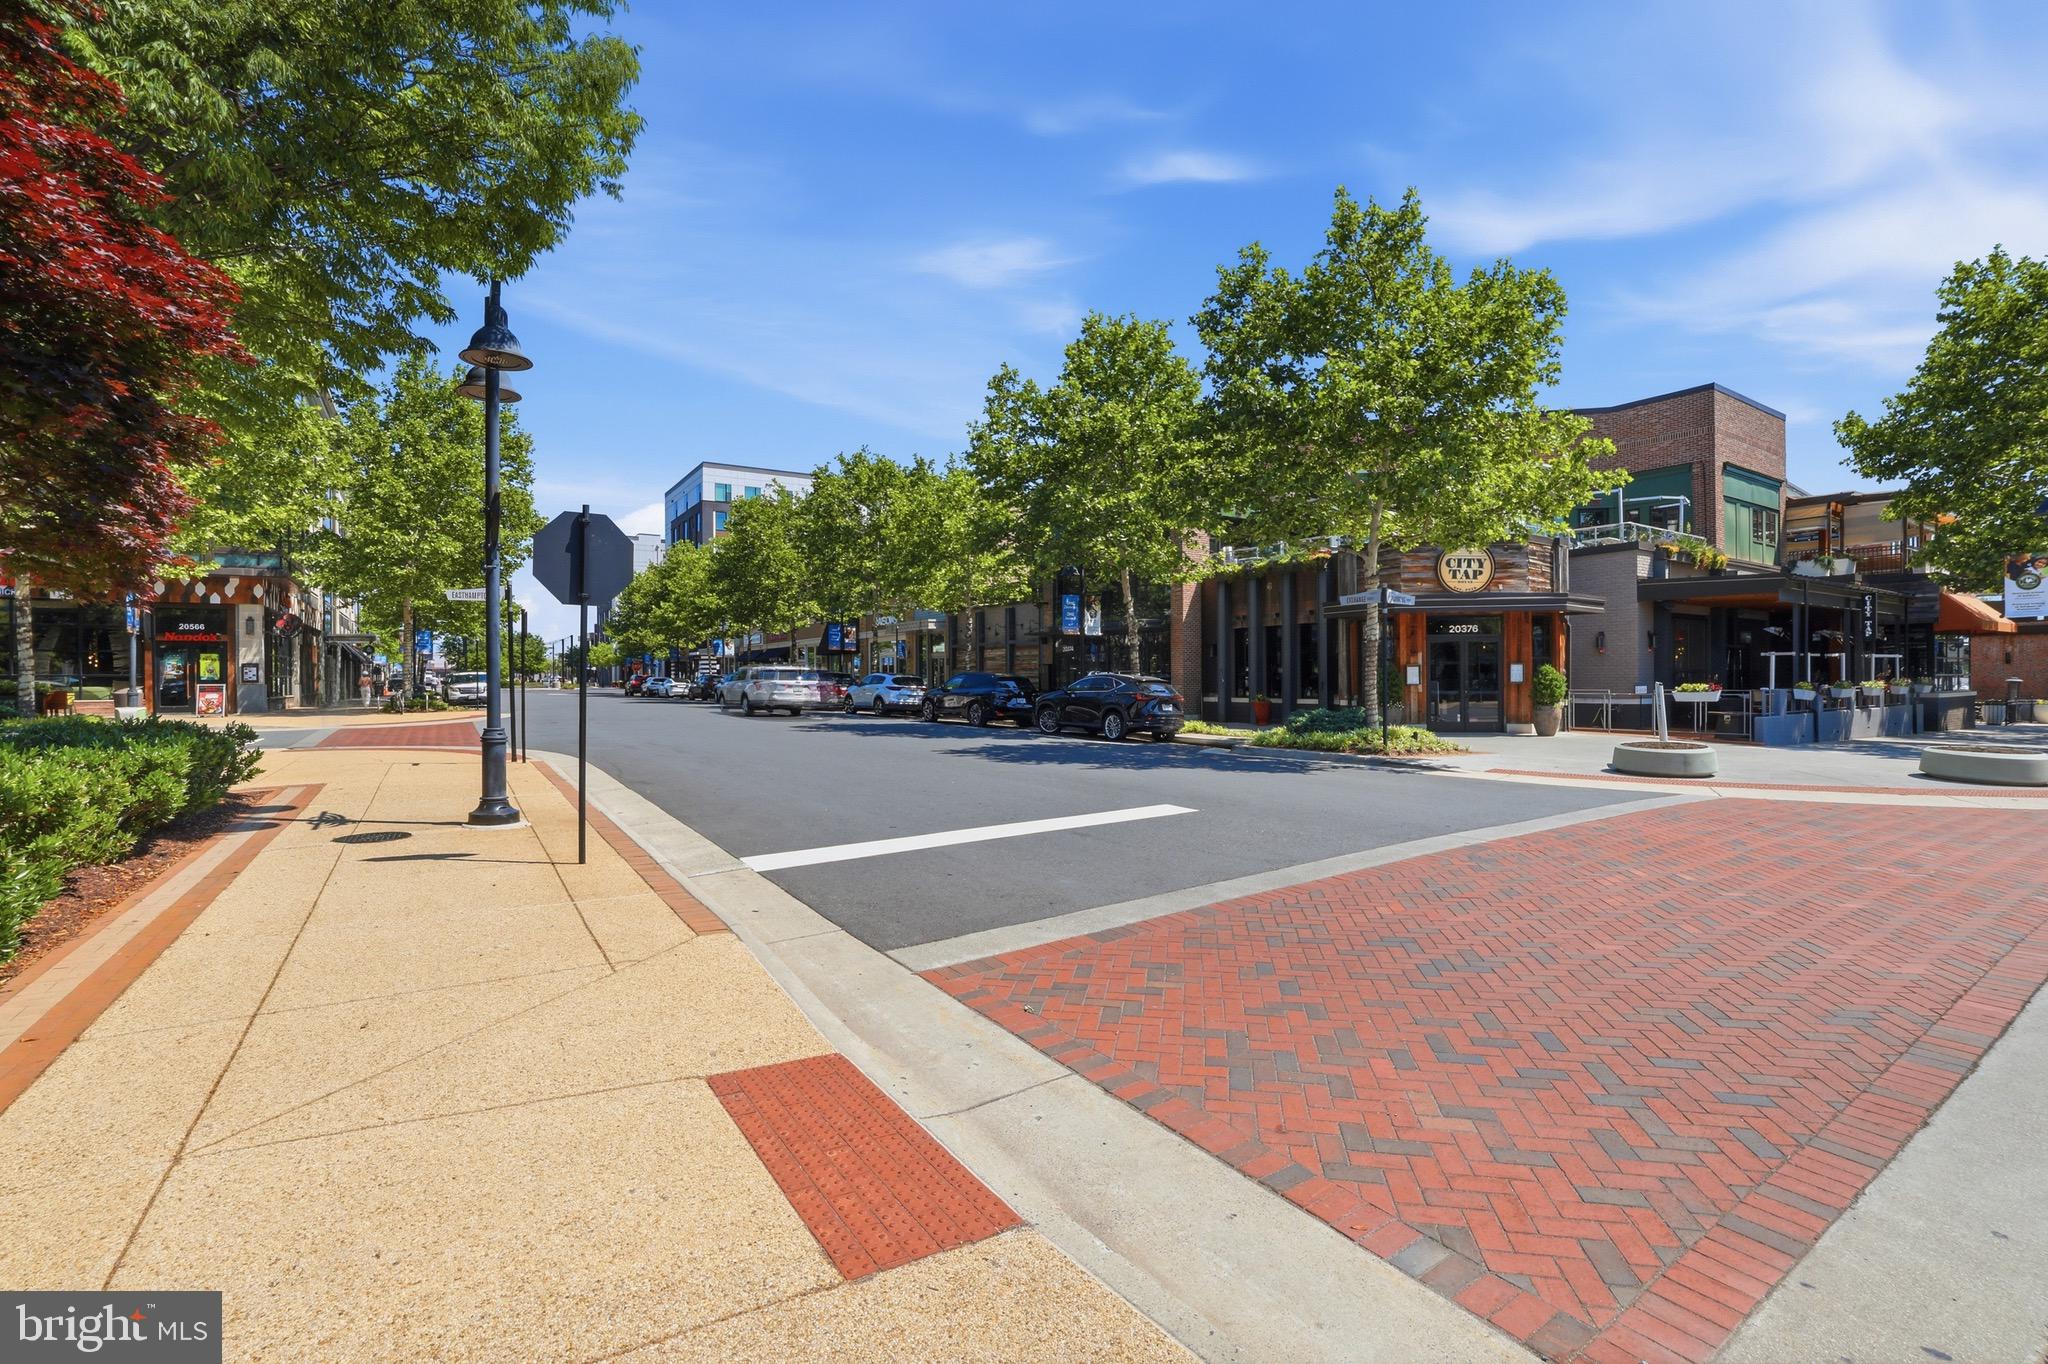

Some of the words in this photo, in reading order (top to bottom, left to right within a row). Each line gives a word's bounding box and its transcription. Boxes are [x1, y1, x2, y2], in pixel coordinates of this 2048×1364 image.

[1445, 557, 1487, 569] CITY
[1449, 569, 1484, 580] TAP
[1449, 625, 1479, 633] 20376
